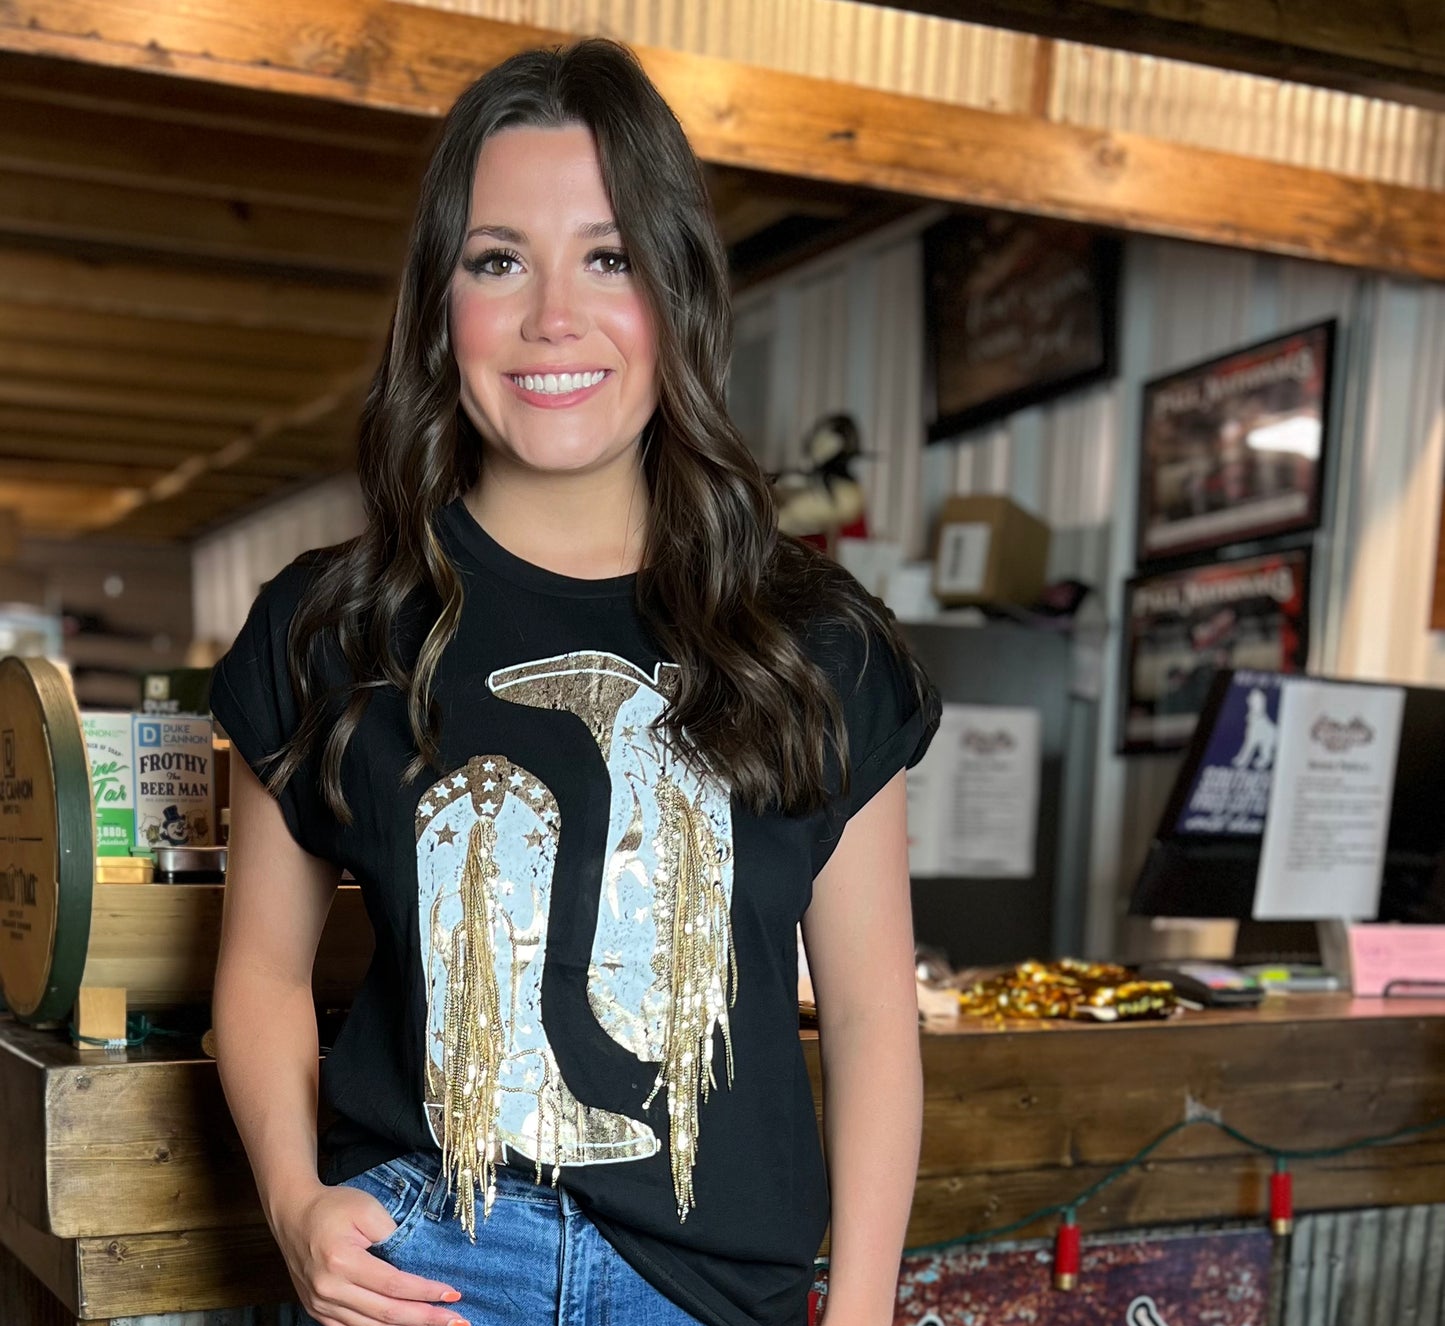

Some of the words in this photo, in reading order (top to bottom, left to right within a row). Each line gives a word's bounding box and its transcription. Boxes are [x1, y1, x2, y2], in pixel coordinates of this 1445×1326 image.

[163, 724, 191, 734] DUKE
[163, 733, 208, 744] CANNON
[90, 761, 130, 777] ine
[139, 752, 209, 775] FROTHY
[166, 772, 181, 781] The
[140, 781, 175, 796] BEER
[178, 783, 209, 797] MAN
